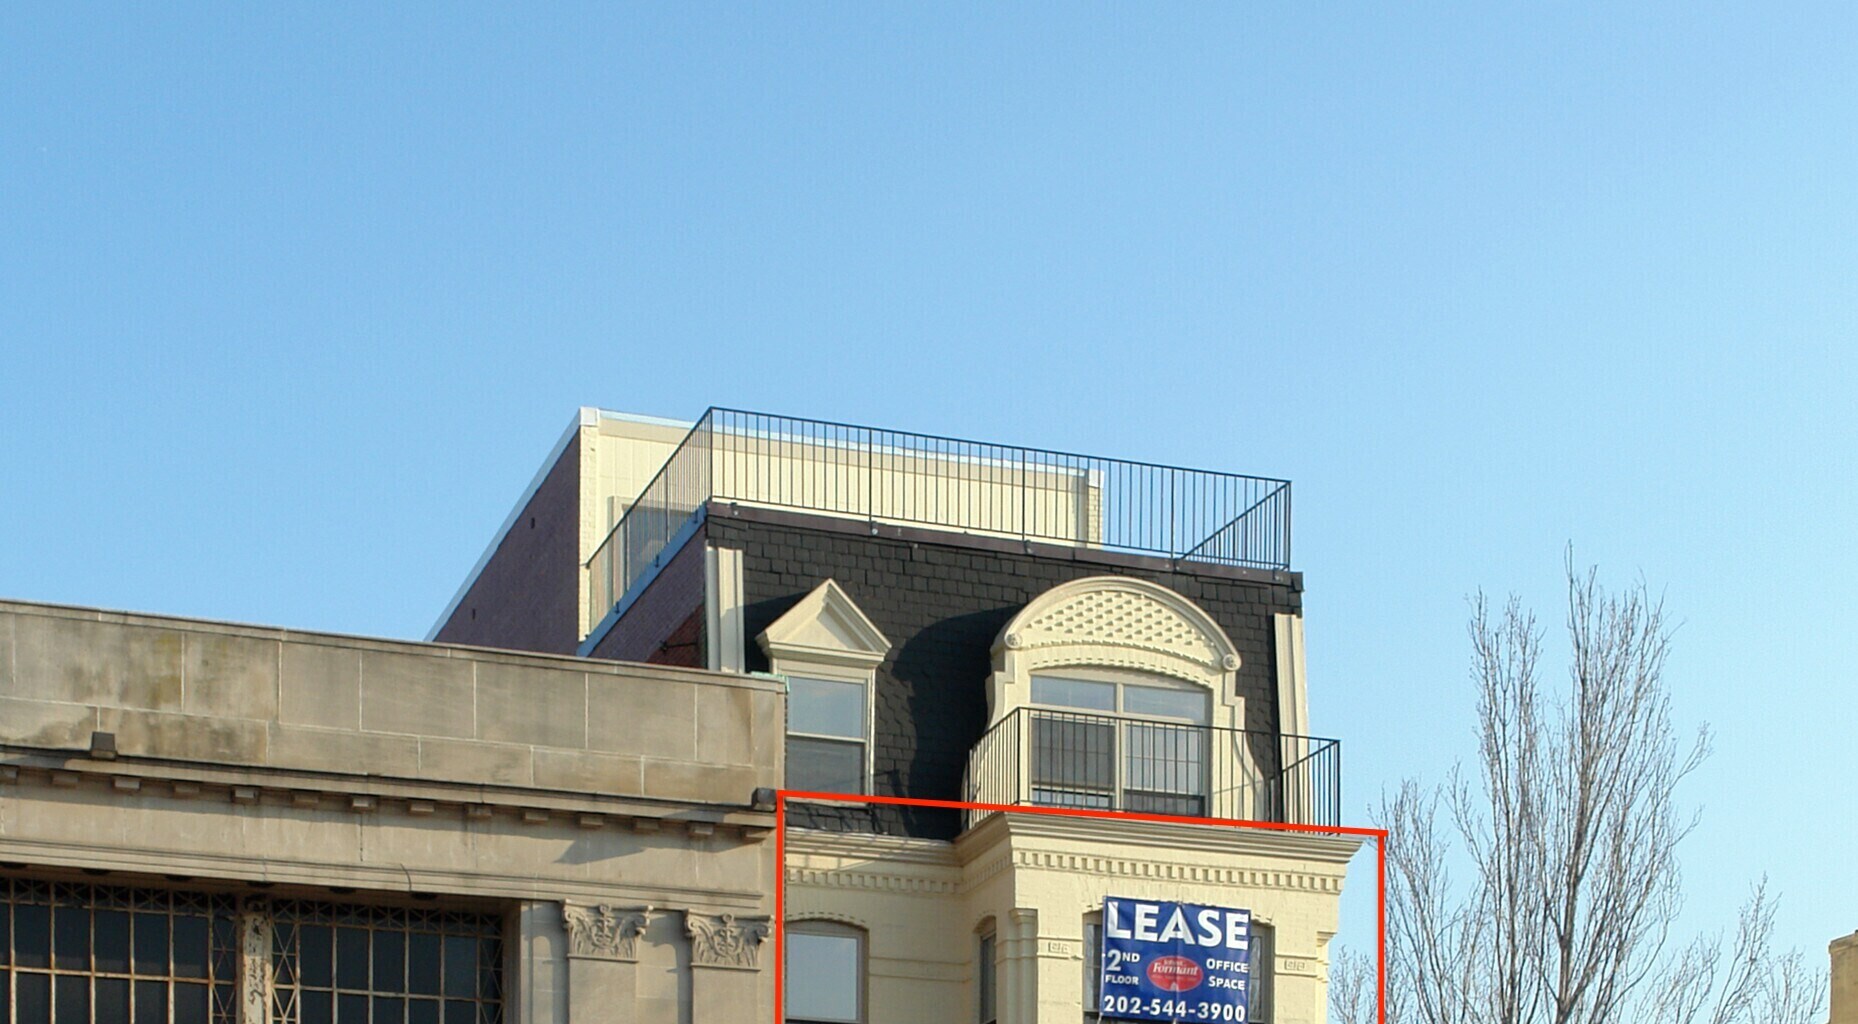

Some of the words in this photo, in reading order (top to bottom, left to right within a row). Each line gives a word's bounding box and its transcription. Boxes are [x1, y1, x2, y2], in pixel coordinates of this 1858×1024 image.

[1107, 902, 1249, 950] LEASE
[1106, 949, 1140, 972] 2ND
[1206, 958, 1249, 973] OFFICE
[1152, 962, 1199, 977] Formant
[1105, 974, 1139, 985] FLOOR
[1208, 976, 1246, 991] SPACE
[1104, 995, 1246, 1023] 202-544-3900
